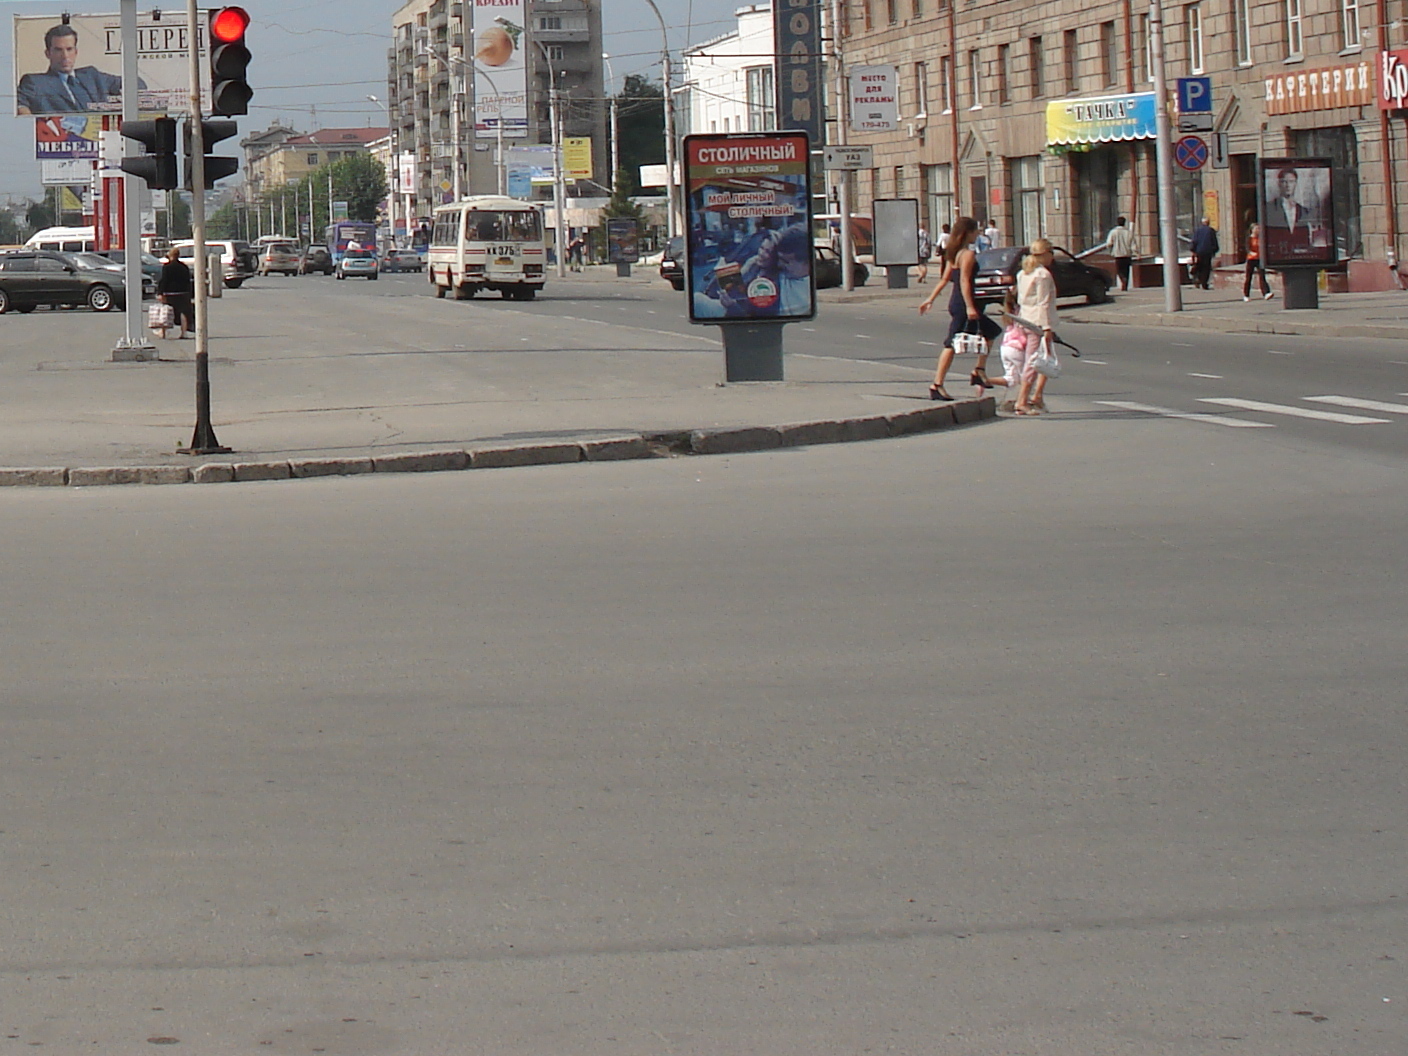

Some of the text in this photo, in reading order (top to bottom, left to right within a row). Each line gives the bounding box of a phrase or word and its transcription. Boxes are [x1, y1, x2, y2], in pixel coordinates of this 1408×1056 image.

[1265, 62, 1368, 101] КАФЕТЕРИЙ
[1186, 81, 1204, 109] P
[1065, 100, 1135, 122] "ТАЧКА"
[698, 142, 796, 163] СТОЛИЧНЫЙ
